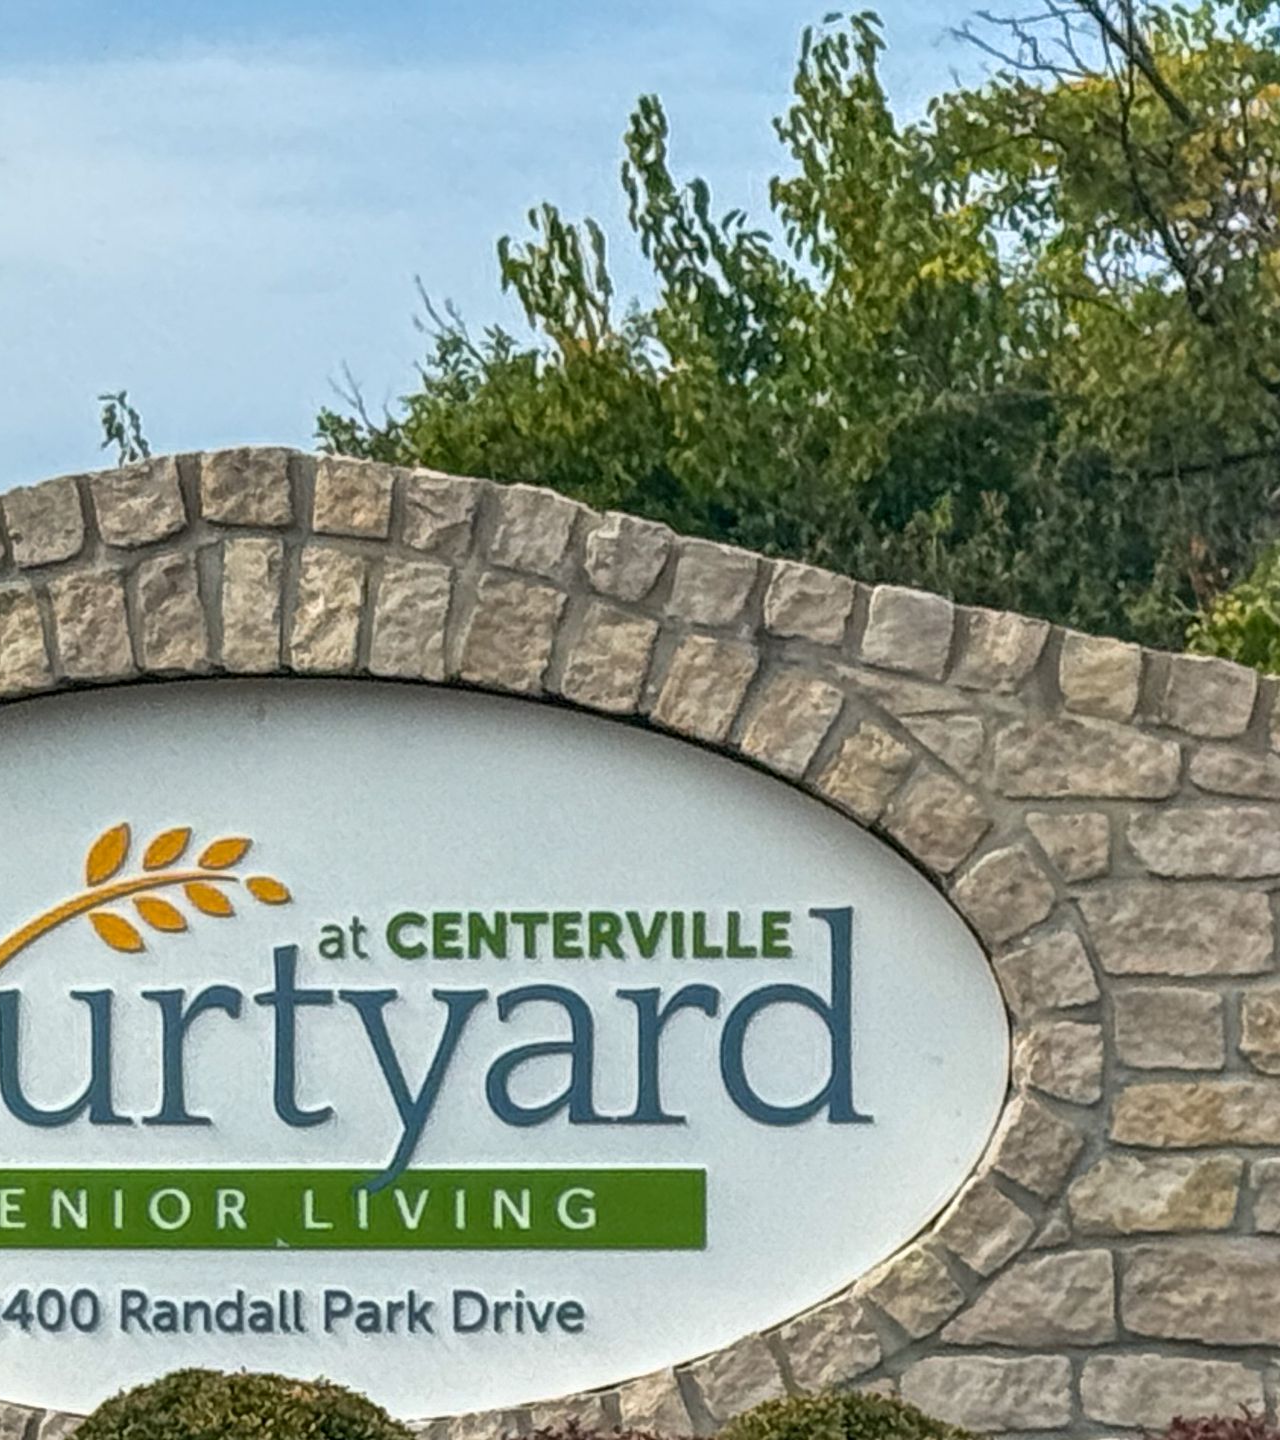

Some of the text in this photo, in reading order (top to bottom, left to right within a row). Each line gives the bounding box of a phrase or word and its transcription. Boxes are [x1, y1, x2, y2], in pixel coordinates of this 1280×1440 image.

[319, 911, 793, 960] at CENTERVILLE
[303, 1186, 601, 1231] LIVING
[118, 1286, 306, 1334] Randall
[324, 1288, 435, 1334] Park
[450, 1288, 587, 1334] Drive
